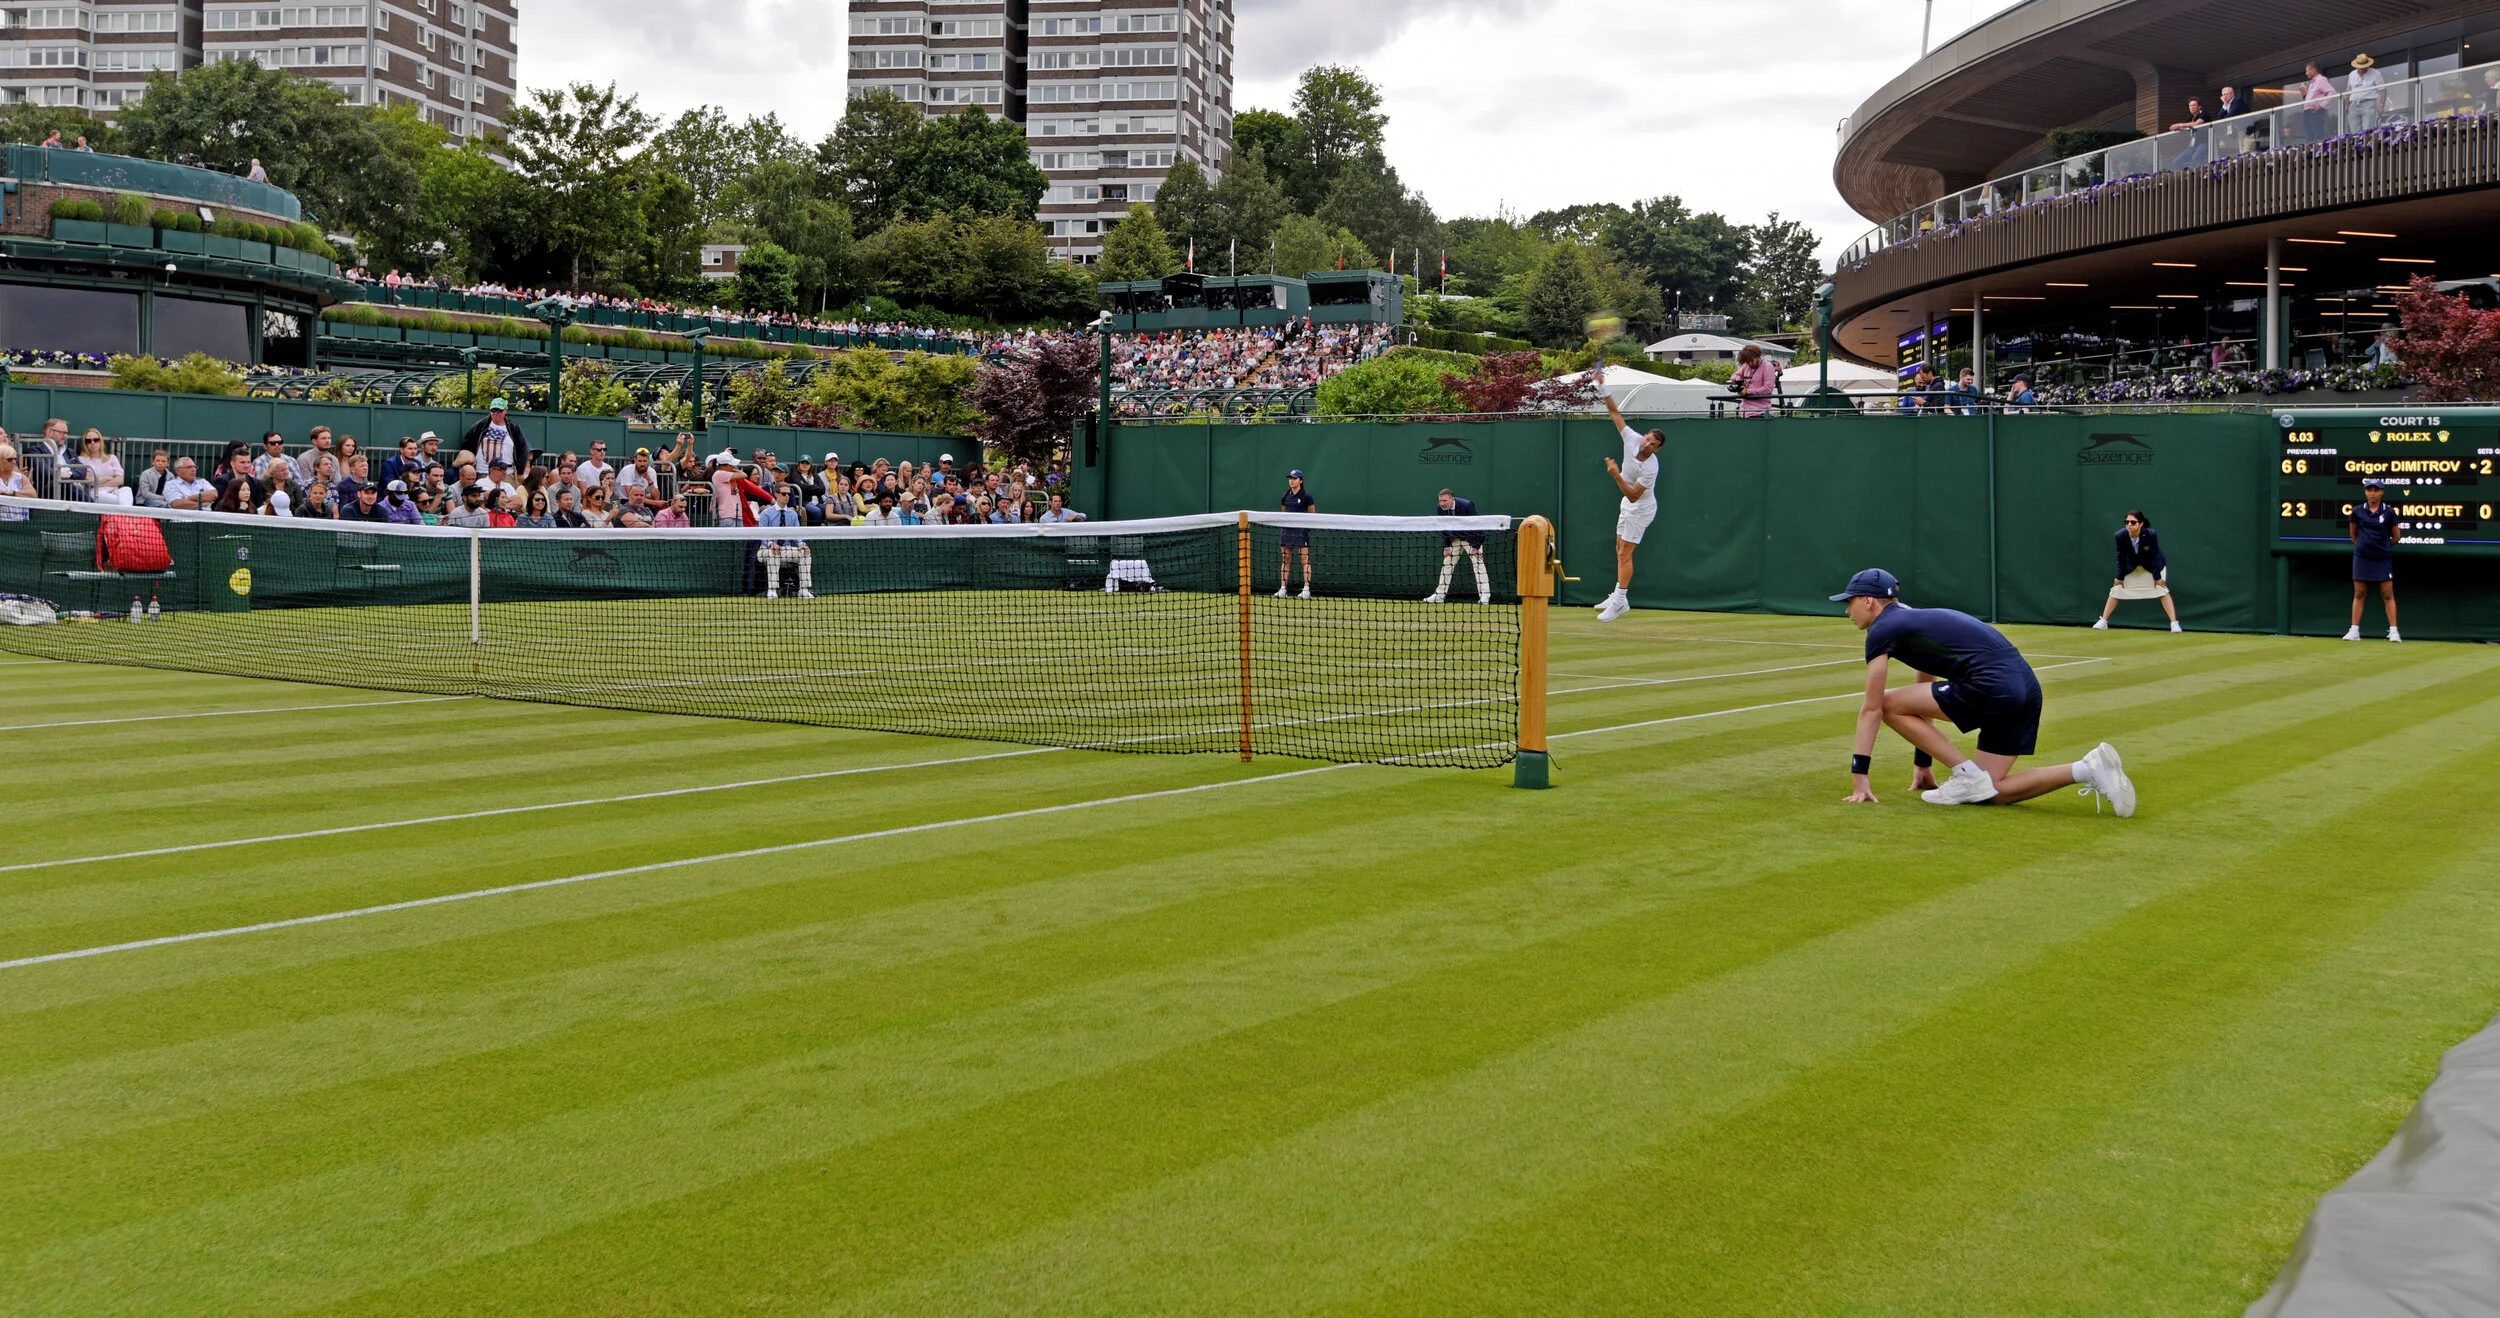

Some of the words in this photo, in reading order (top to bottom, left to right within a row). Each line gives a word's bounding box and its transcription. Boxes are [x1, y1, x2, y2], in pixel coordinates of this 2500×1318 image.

[2380, 416, 2424, 426] COURT
[2427, 416, 2440, 426] 15
[2288, 431, 2314, 443] 6.03
[2386, 432, 2431, 442] ROLEX
[1418, 451, 1472, 465] Slazenger
[2076, 450, 2154, 466] Slazenger
[2281, 459, 2293, 474] 6
[2296, 459, 2307, 474] 6
[2344, 460, 2389, 474] Grigor
[2391, 460, 2460, 472] DIMITROV
[2479, 459, 2492, 474] 2
[2281, 502, 2292, 517] 2
[2296, 502, 2307, 517] 3
[2402, 504, 2463, 517] MOUTET
[2479, 503, 2492, 519] 0
